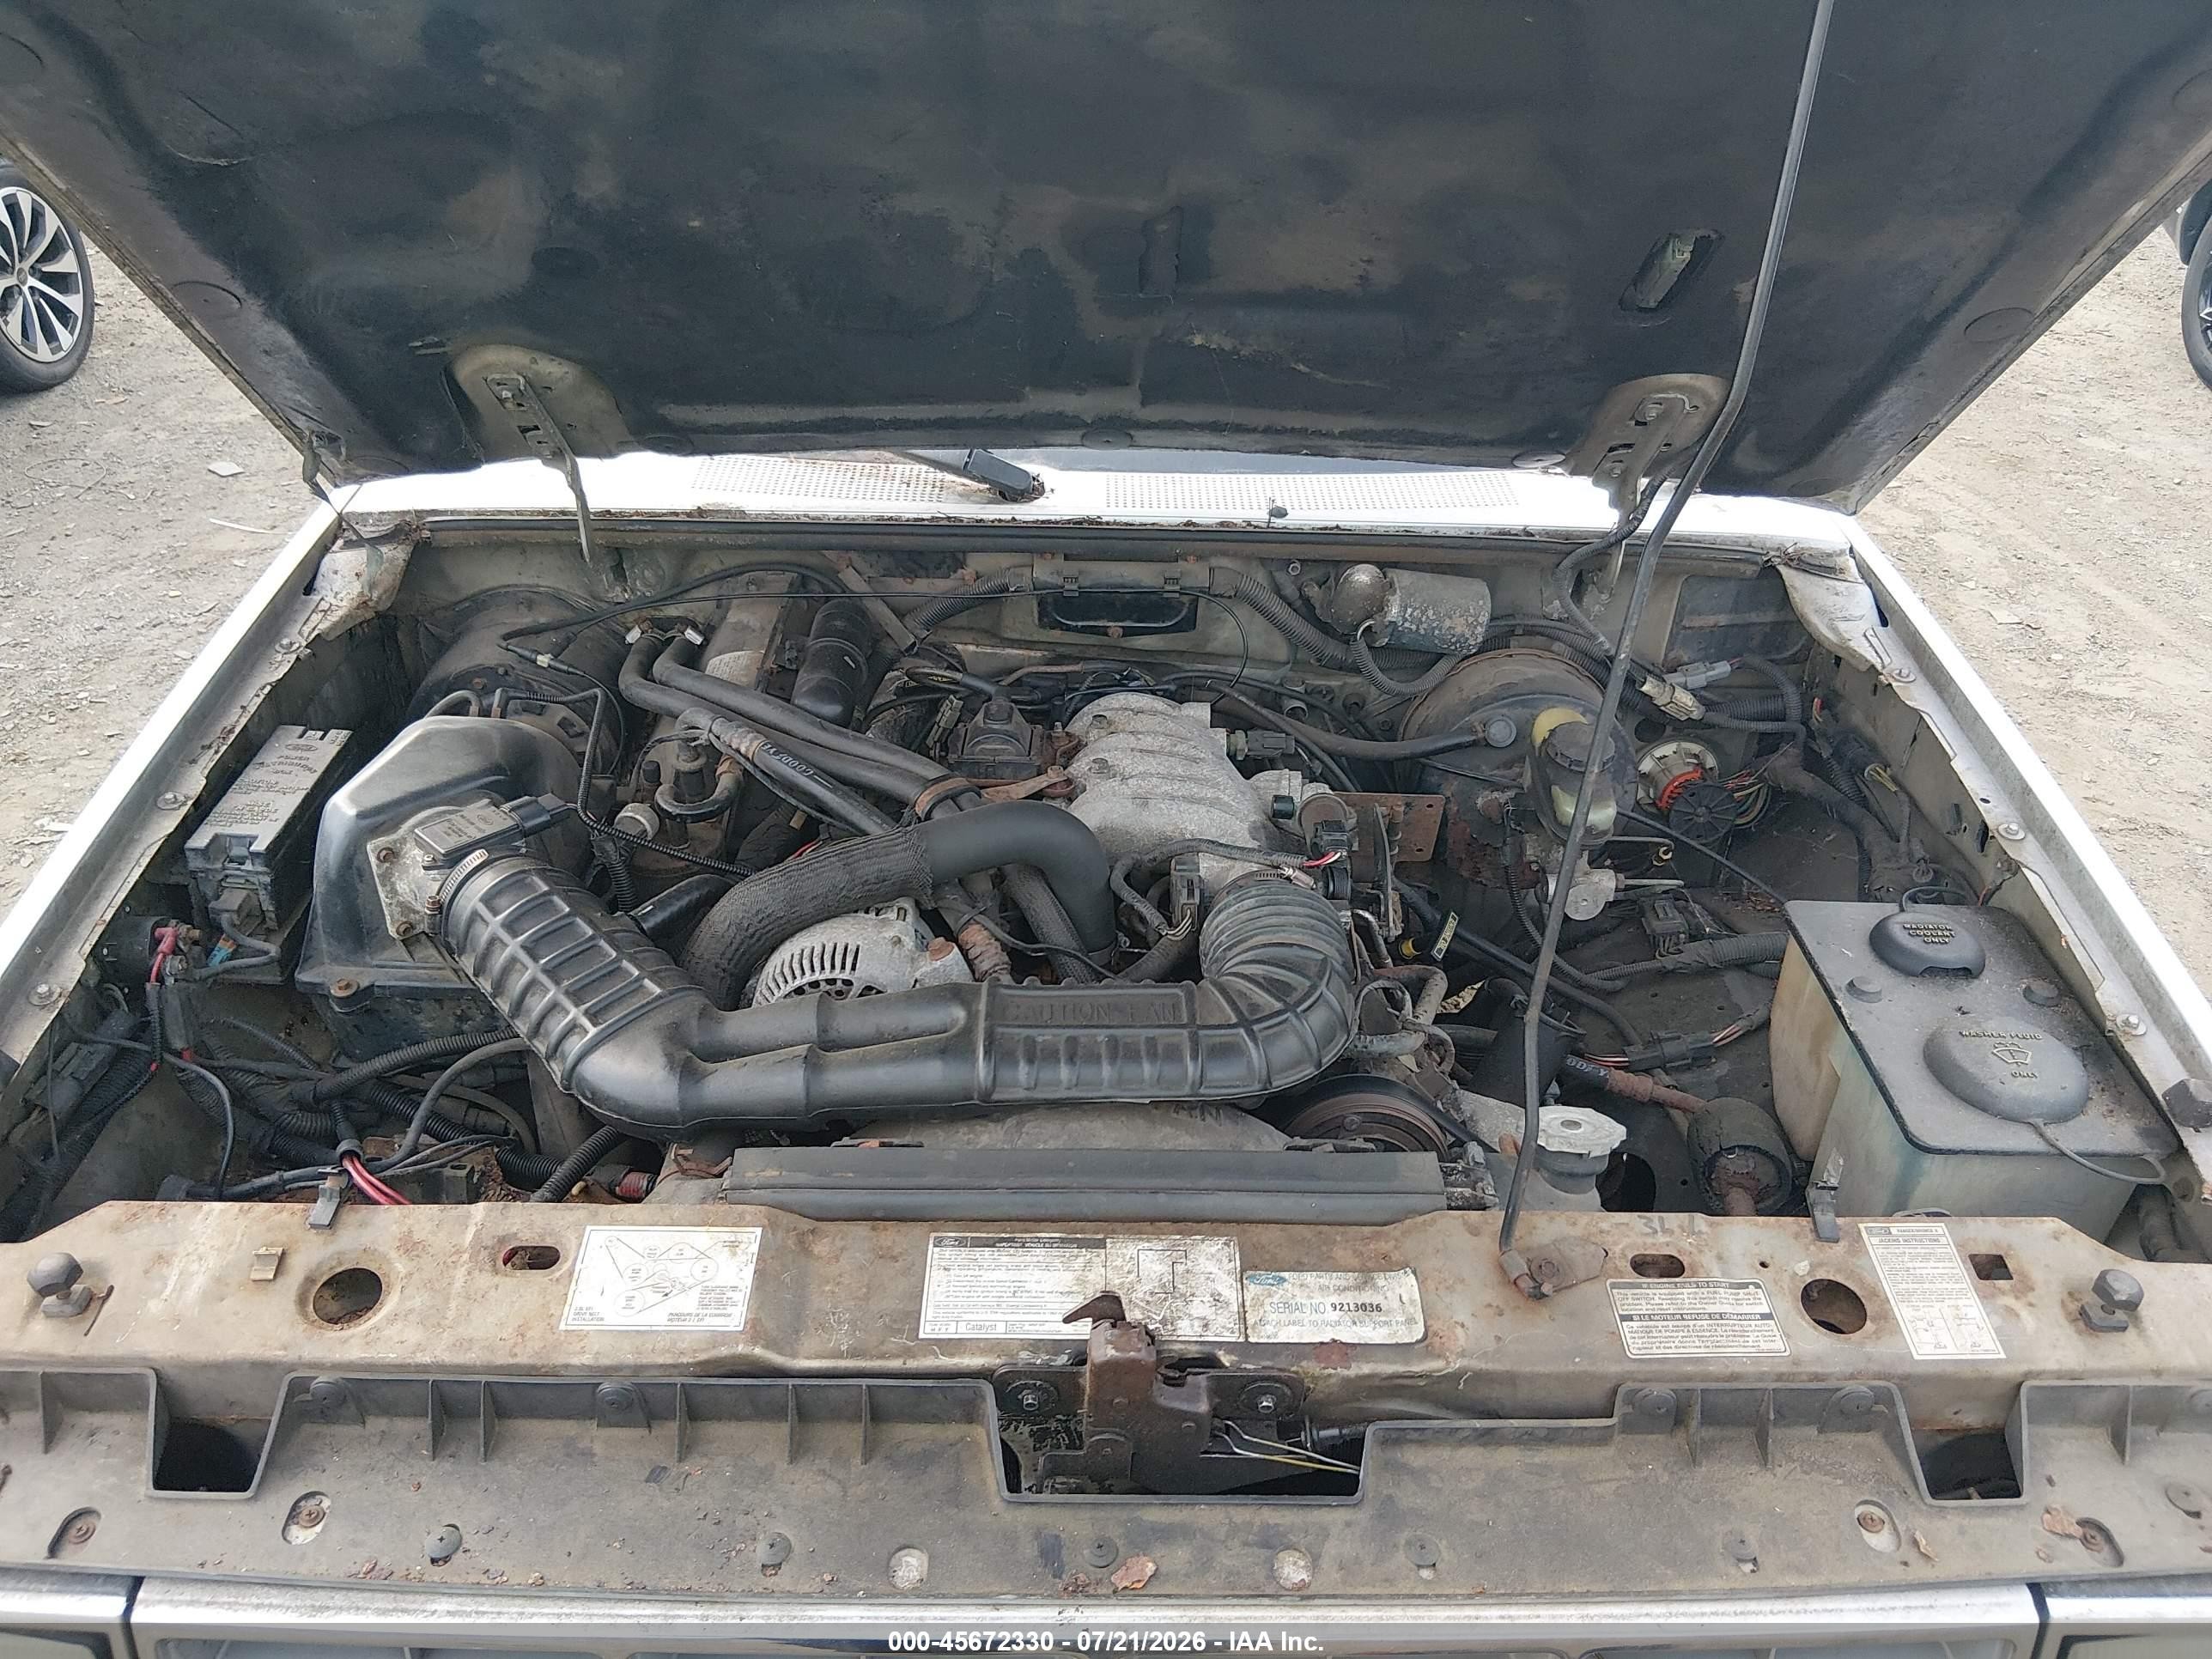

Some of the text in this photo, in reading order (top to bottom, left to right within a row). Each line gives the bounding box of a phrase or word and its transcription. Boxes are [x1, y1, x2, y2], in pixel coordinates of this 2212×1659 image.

[762, 742, 814, 776] GOODYE
[1903, 923, 1954, 932] RADIATOR
[1960, 1030, 2006, 1039] WASHER
[1270, 1301, 1307, 1314] SERIAL
[1331, 1302, 1382, 1313] 9213036
[965, 1322, 997, 1332] Catalyst
